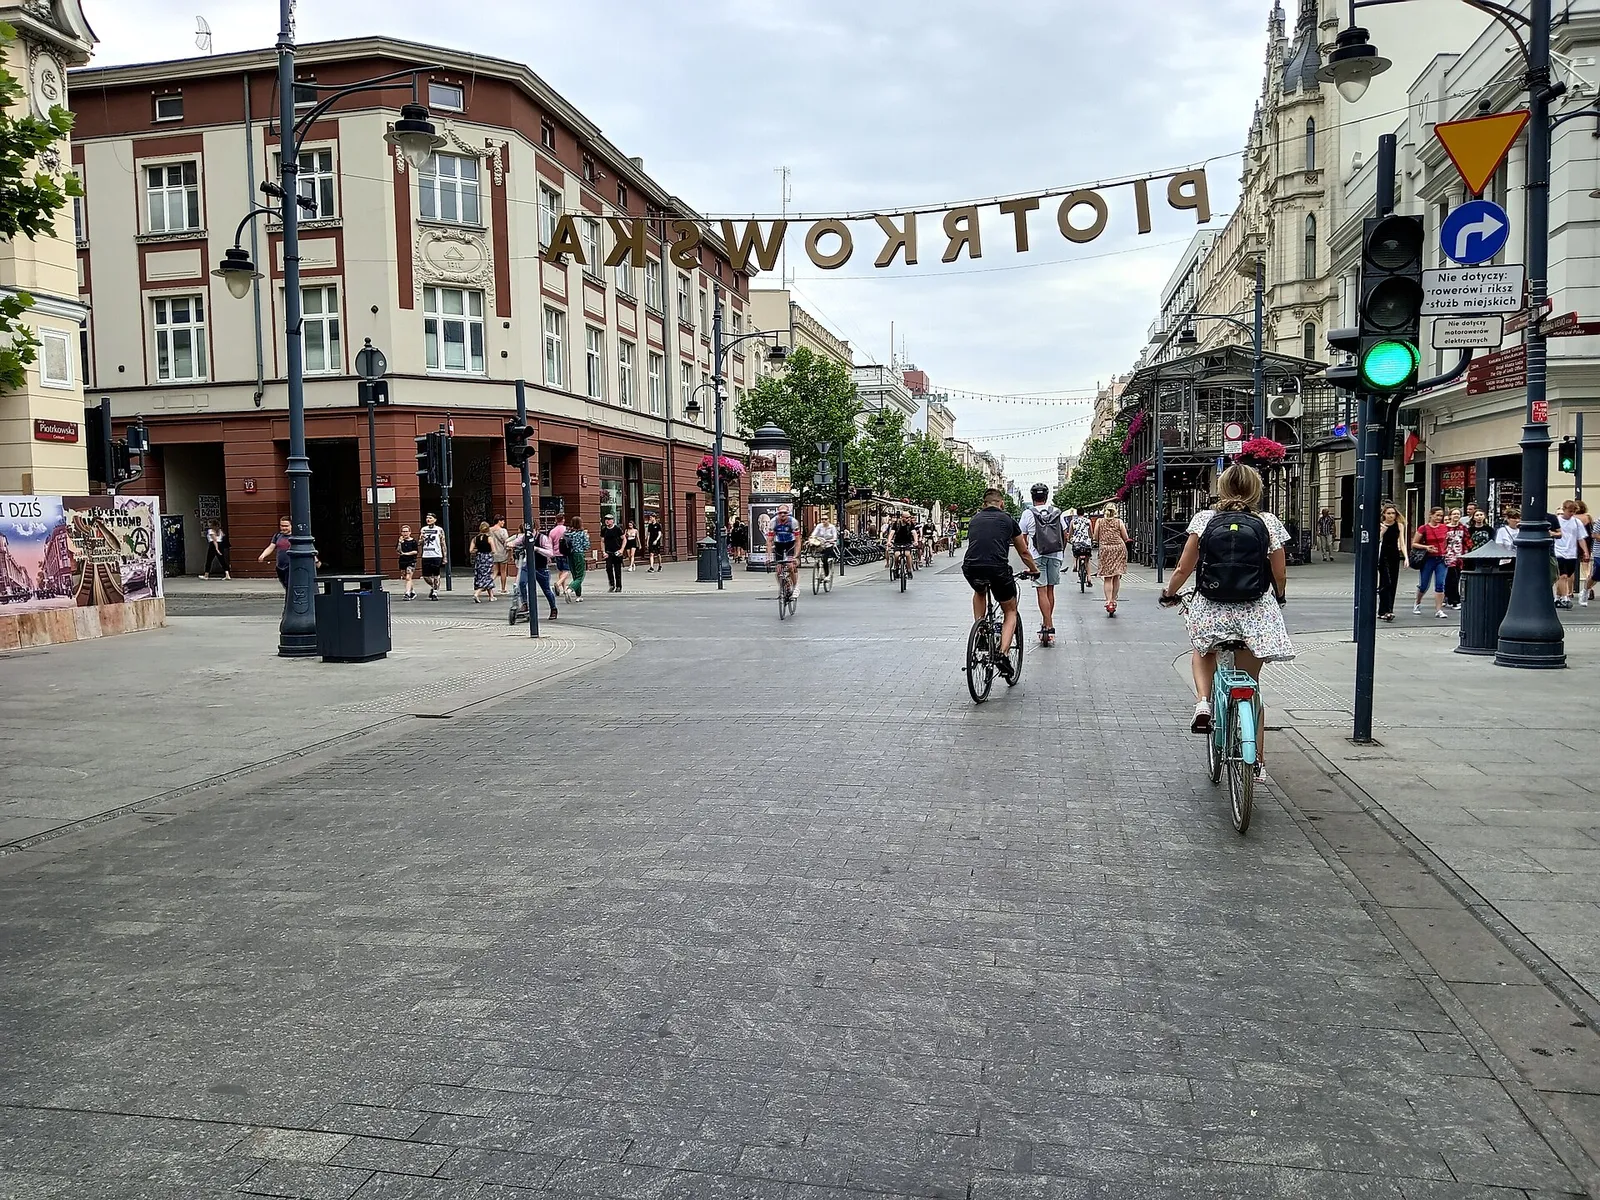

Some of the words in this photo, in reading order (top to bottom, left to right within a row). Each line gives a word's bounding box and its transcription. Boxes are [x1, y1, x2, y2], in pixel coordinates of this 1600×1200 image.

[1438, 273, 1457, 282] Nie
[1461, 272, 1507, 282] dotyczy:
[1426, 285, 1478, 295] -rowerów
[1487, 283, 1512, 293] riksz
[1426, 298, 1459, 308] -służb
[1464, 296, 1516, 308] miejskich
[40, 424, 75, 434] Piotrkowska
[9, 497, 42, 518] DZIŚ
[116, 516, 142, 527] BOMB
